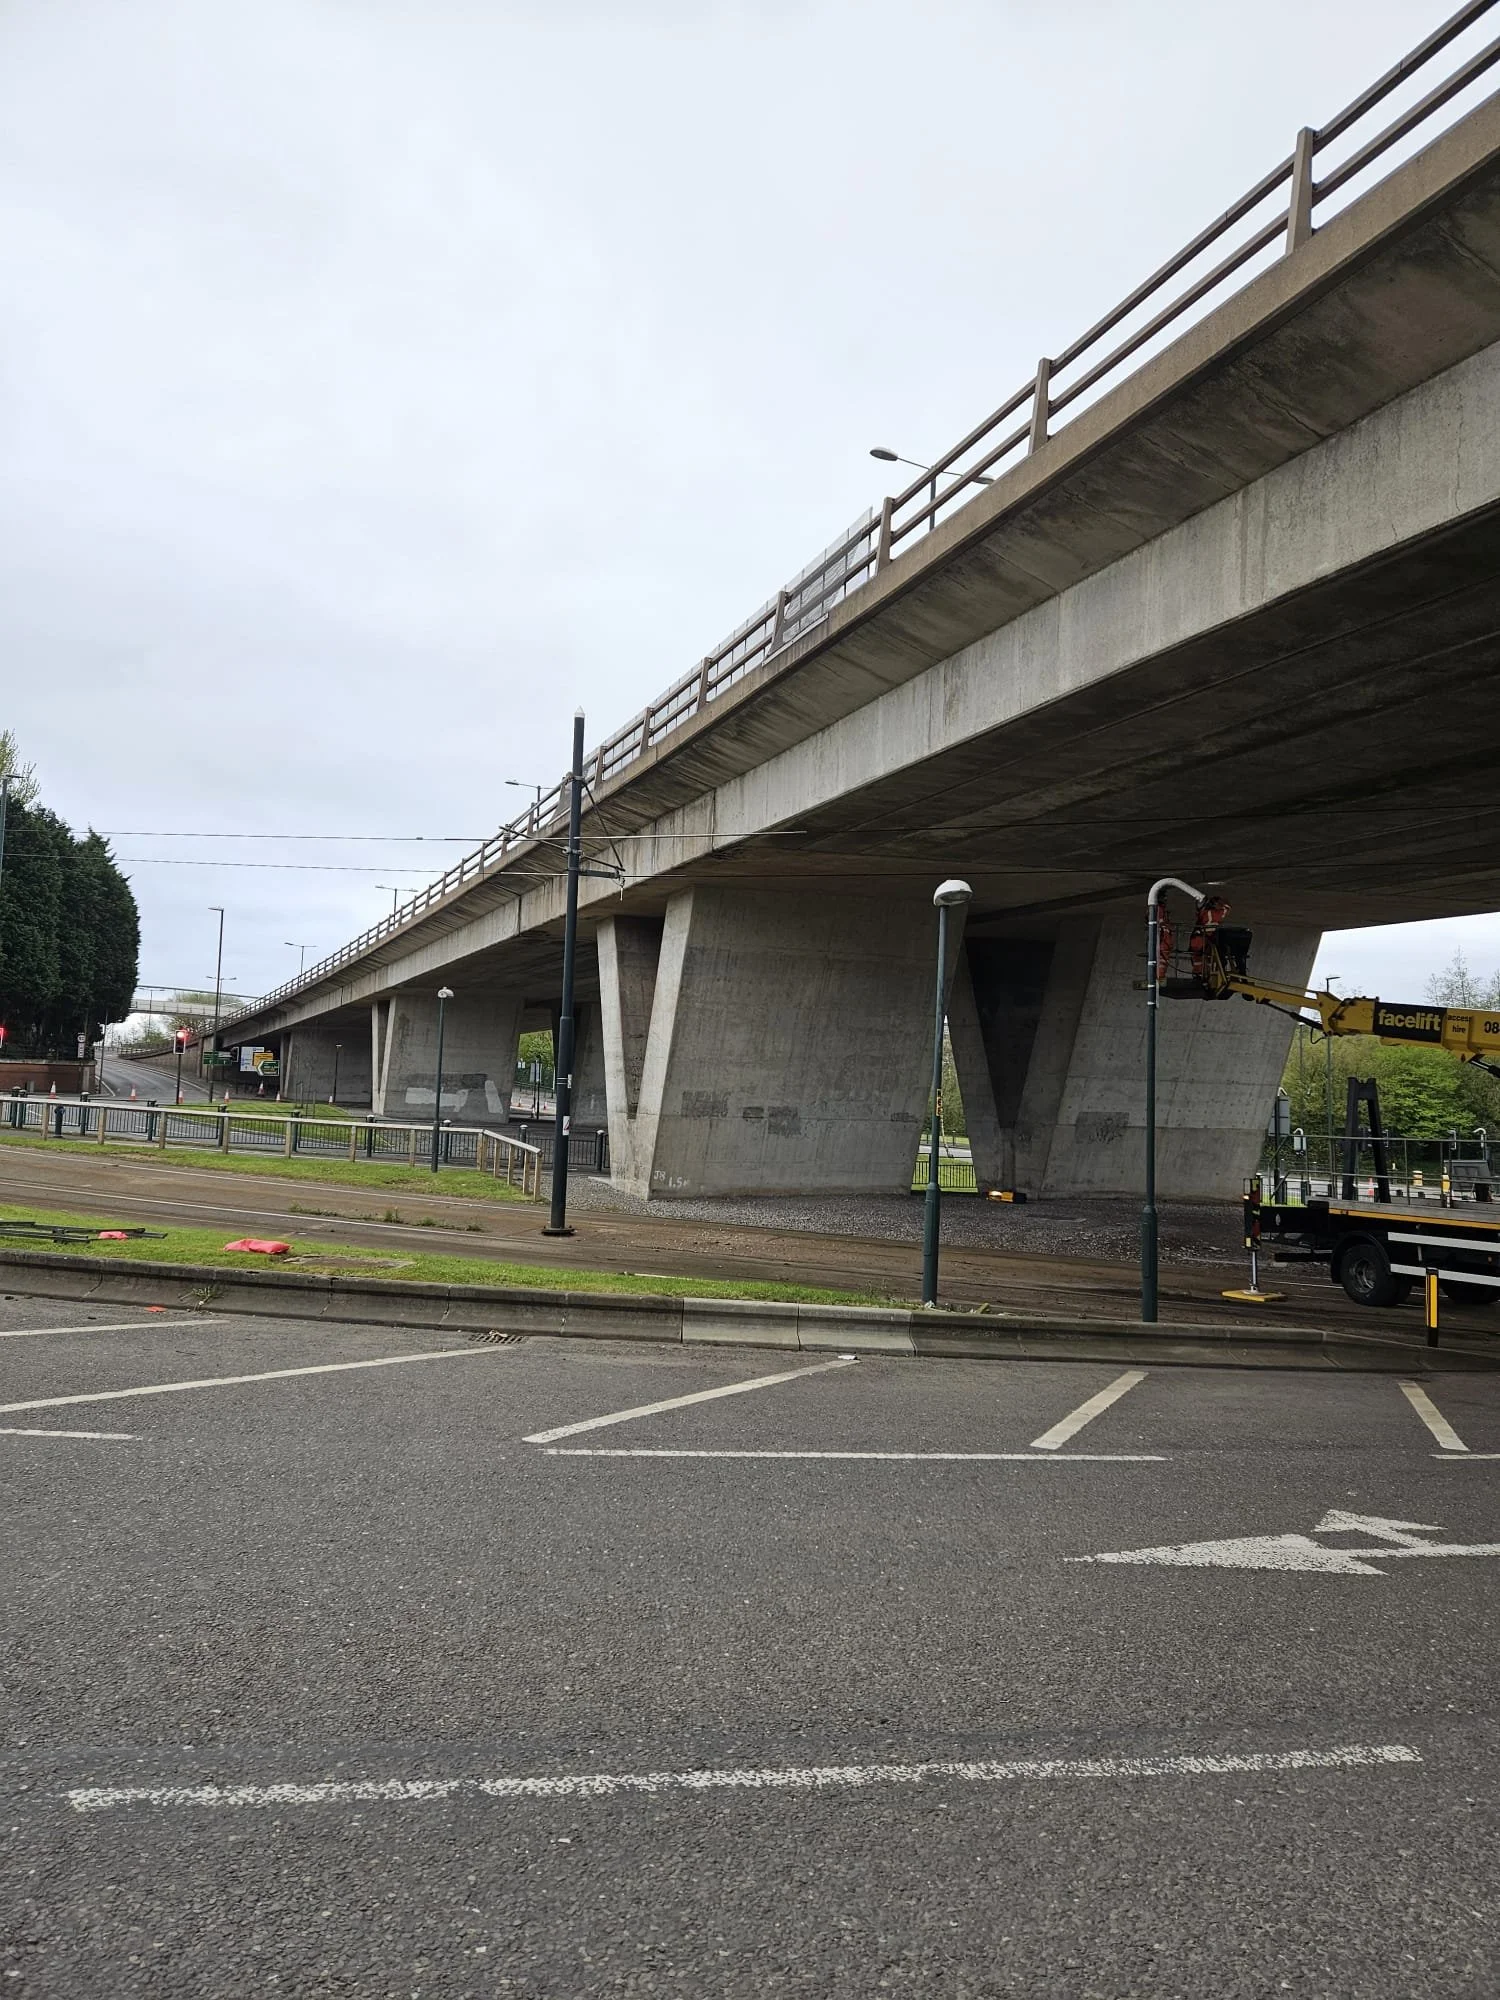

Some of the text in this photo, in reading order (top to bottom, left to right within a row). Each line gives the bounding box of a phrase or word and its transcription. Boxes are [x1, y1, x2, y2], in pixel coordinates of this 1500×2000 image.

[1378, 1009, 1441, 1031] facelift
[1484, 1020, 1500, 1034] 08
[1452, 1024, 1466, 1033] hire
